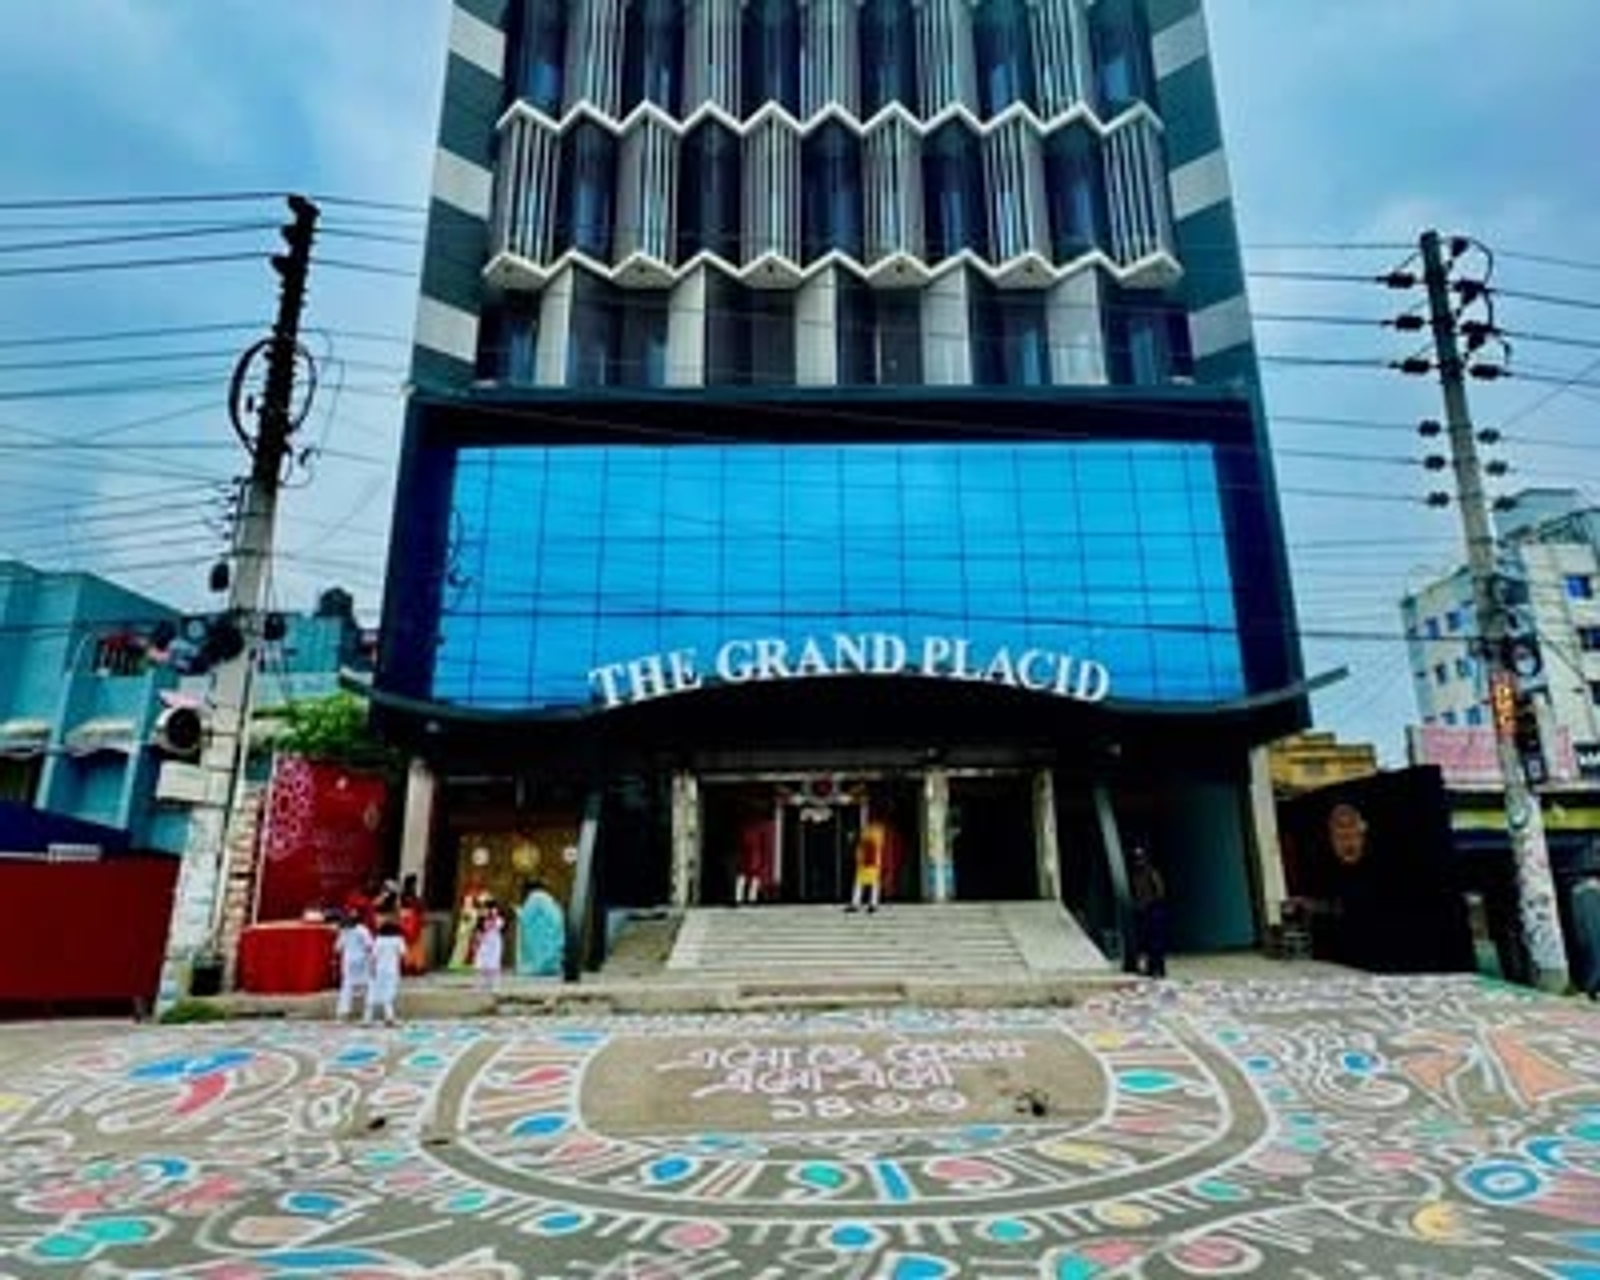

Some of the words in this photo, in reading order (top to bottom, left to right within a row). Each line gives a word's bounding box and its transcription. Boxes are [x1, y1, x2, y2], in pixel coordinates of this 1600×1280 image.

[589, 649, 700, 708] THE
[717, 633, 906, 682] GRAND
[923, 638, 1109, 702] PLACID
